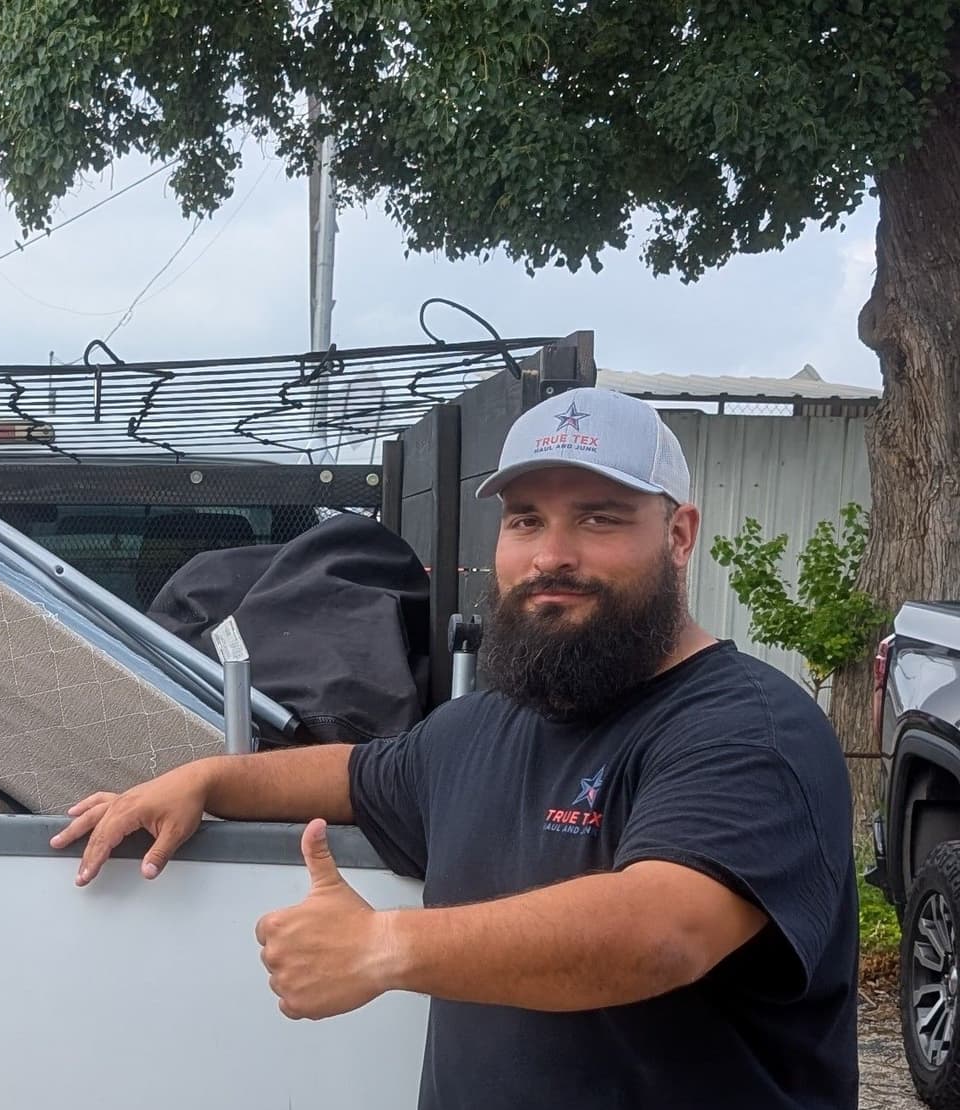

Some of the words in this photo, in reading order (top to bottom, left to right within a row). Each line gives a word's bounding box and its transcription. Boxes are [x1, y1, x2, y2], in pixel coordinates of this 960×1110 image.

[535, 433, 568, 448] TRUE
[572, 434, 599, 447] TEX
[575, 445, 597, 453] JUNK
[545, 809, 581, 824] TRUE
